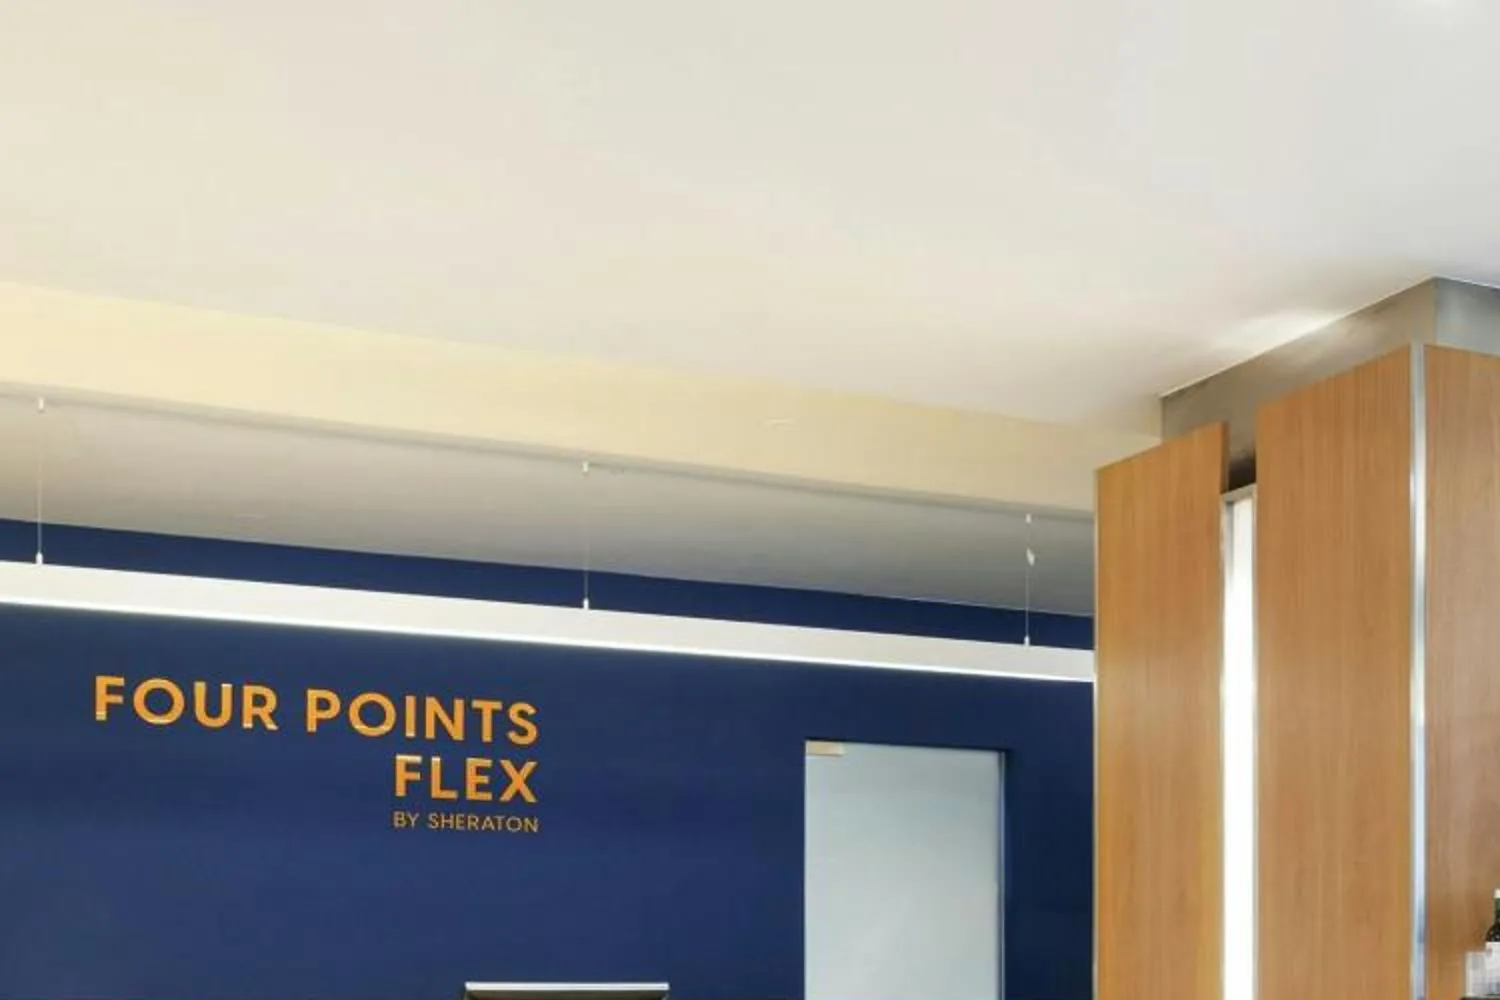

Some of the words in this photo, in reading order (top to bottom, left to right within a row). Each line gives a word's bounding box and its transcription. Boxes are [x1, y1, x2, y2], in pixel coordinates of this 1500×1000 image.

[95, 675, 278, 731] FOUR
[306, 688, 538, 745] POINTS
[394, 753, 538, 803] FLEX
[393, 811, 420, 829] BY
[428, 813, 538, 833] SHERATON
